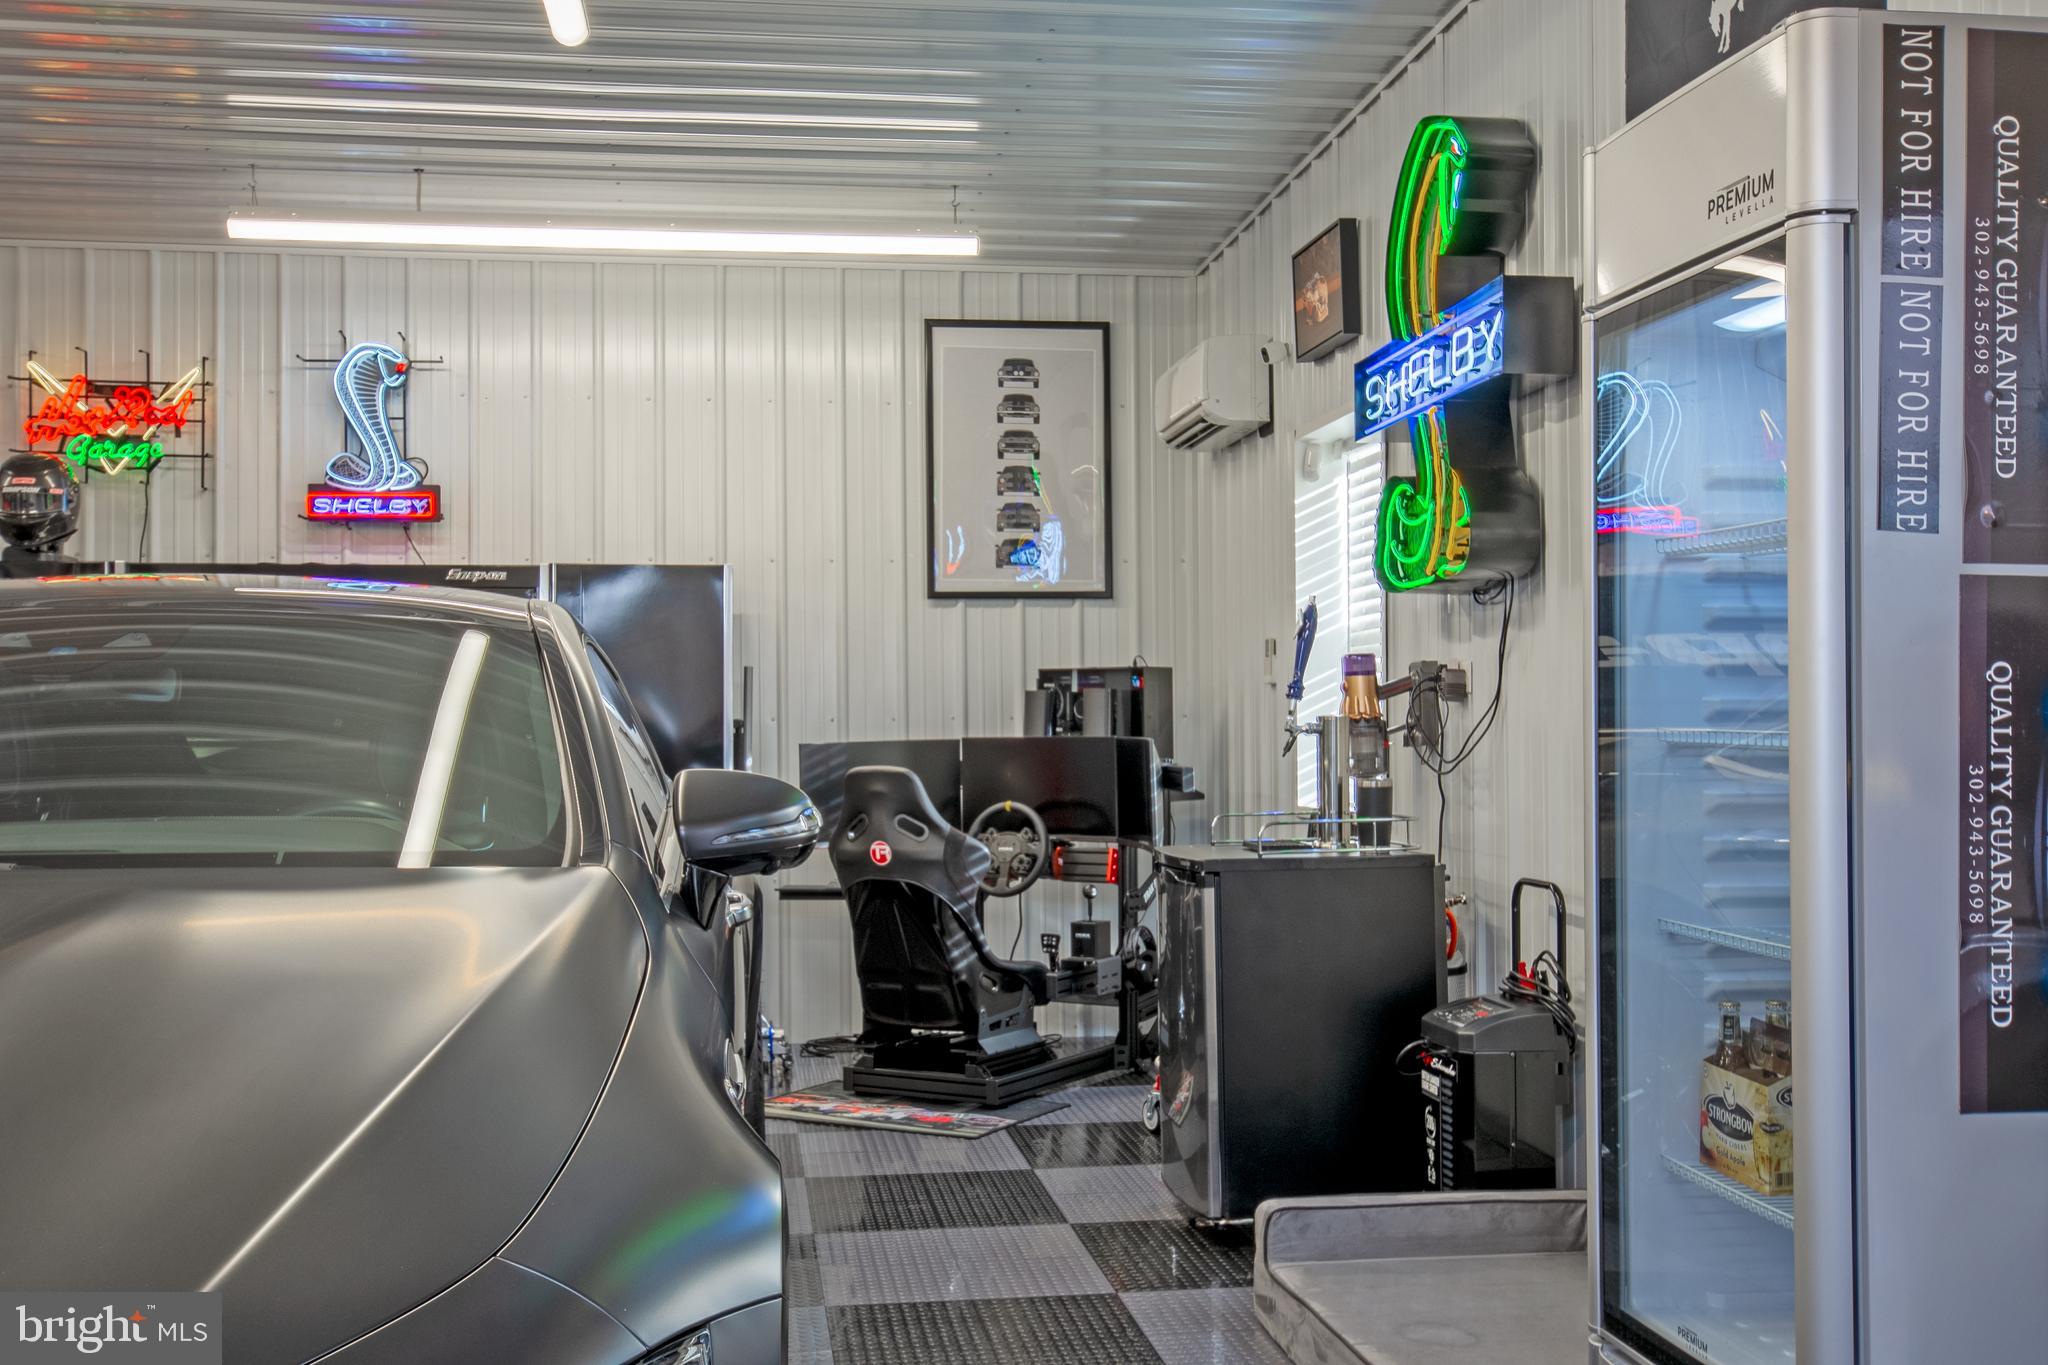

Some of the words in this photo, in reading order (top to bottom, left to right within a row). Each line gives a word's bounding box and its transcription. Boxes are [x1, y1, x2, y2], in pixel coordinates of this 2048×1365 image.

[1901, 28, 1932, 95] NOT
[1900, 108, 1932, 171] FOR
[1708, 169, 1774, 219] PREMIUM
[1725, 196, 1774, 225] LEVELLA
[1994, 115, 2019, 252] QUALITY
[1900, 187, 1931, 271] HIRE
[1899, 289, 1930, 356] NOT
[1974, 218, 1990, 375] 302-943-5698
[1366, 311, 1503, 420] SHELBY
[1995, 257, 2018, 479] GUARANTEED
[1898, 369, 1929, 433] FOR
[66, 434, 164, 467] Garage
[313, 498, 428, 515] SHELBY
[1897, 448, 1927, 531] HIRE
[1986, 661, 2013, 800] QUALITY
[1968, 765, 1984, 924] 302-943-5698
[1990, 804, 2014, 1028] GUARANTEED
[1708, 1104, 1753, 1135] STRONGBOW
[1677, 1326, 1708, 1353] PREMIUM
